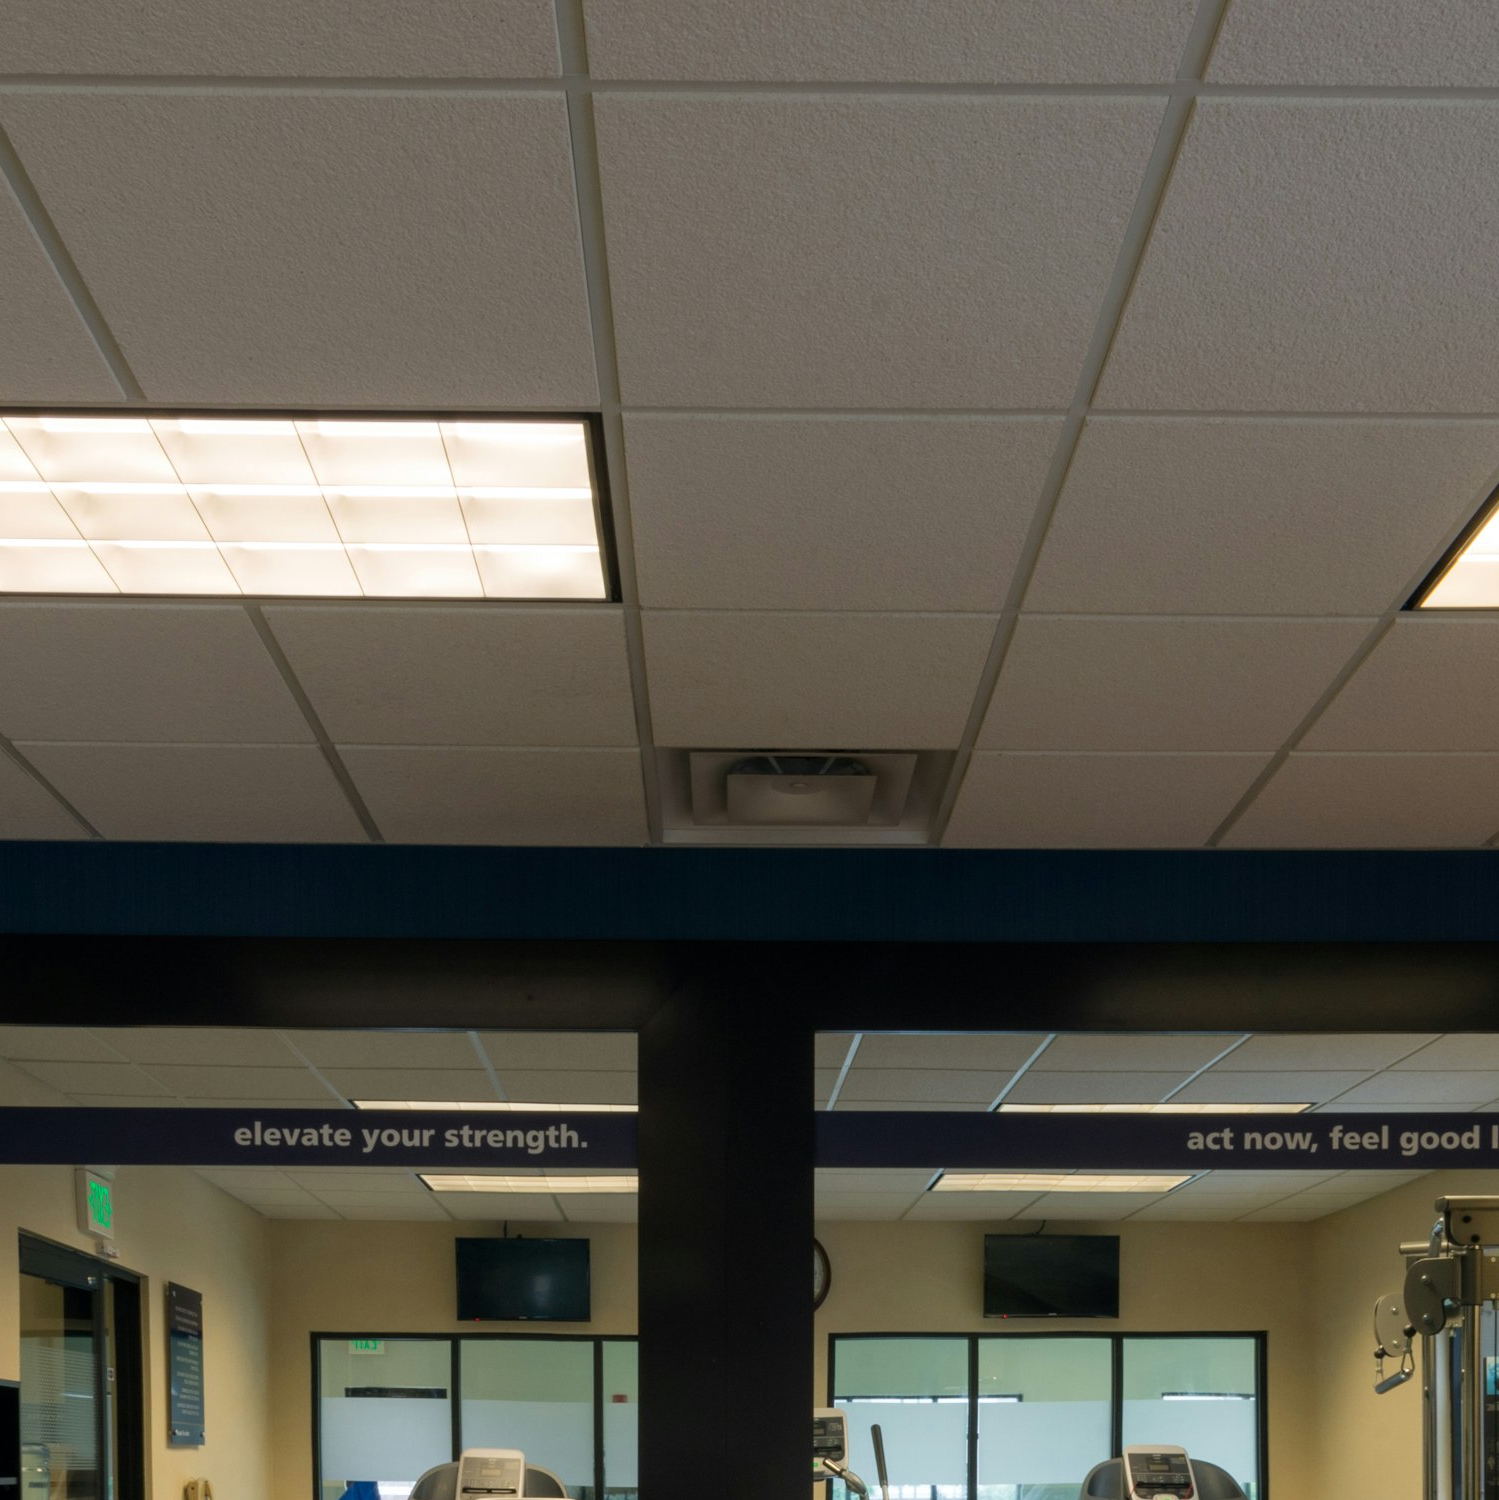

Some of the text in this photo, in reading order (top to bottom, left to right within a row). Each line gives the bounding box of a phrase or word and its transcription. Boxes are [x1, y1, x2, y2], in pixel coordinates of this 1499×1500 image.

[234, 1121, 589, 1155] elevate your strength.
[1187, 1127, 1234, 1150] act
[1244, 1131, 1319, 1154] now,
[1329, 1125, 1389, 1150] feel
[1400, 1125, 1480, 1156] good
